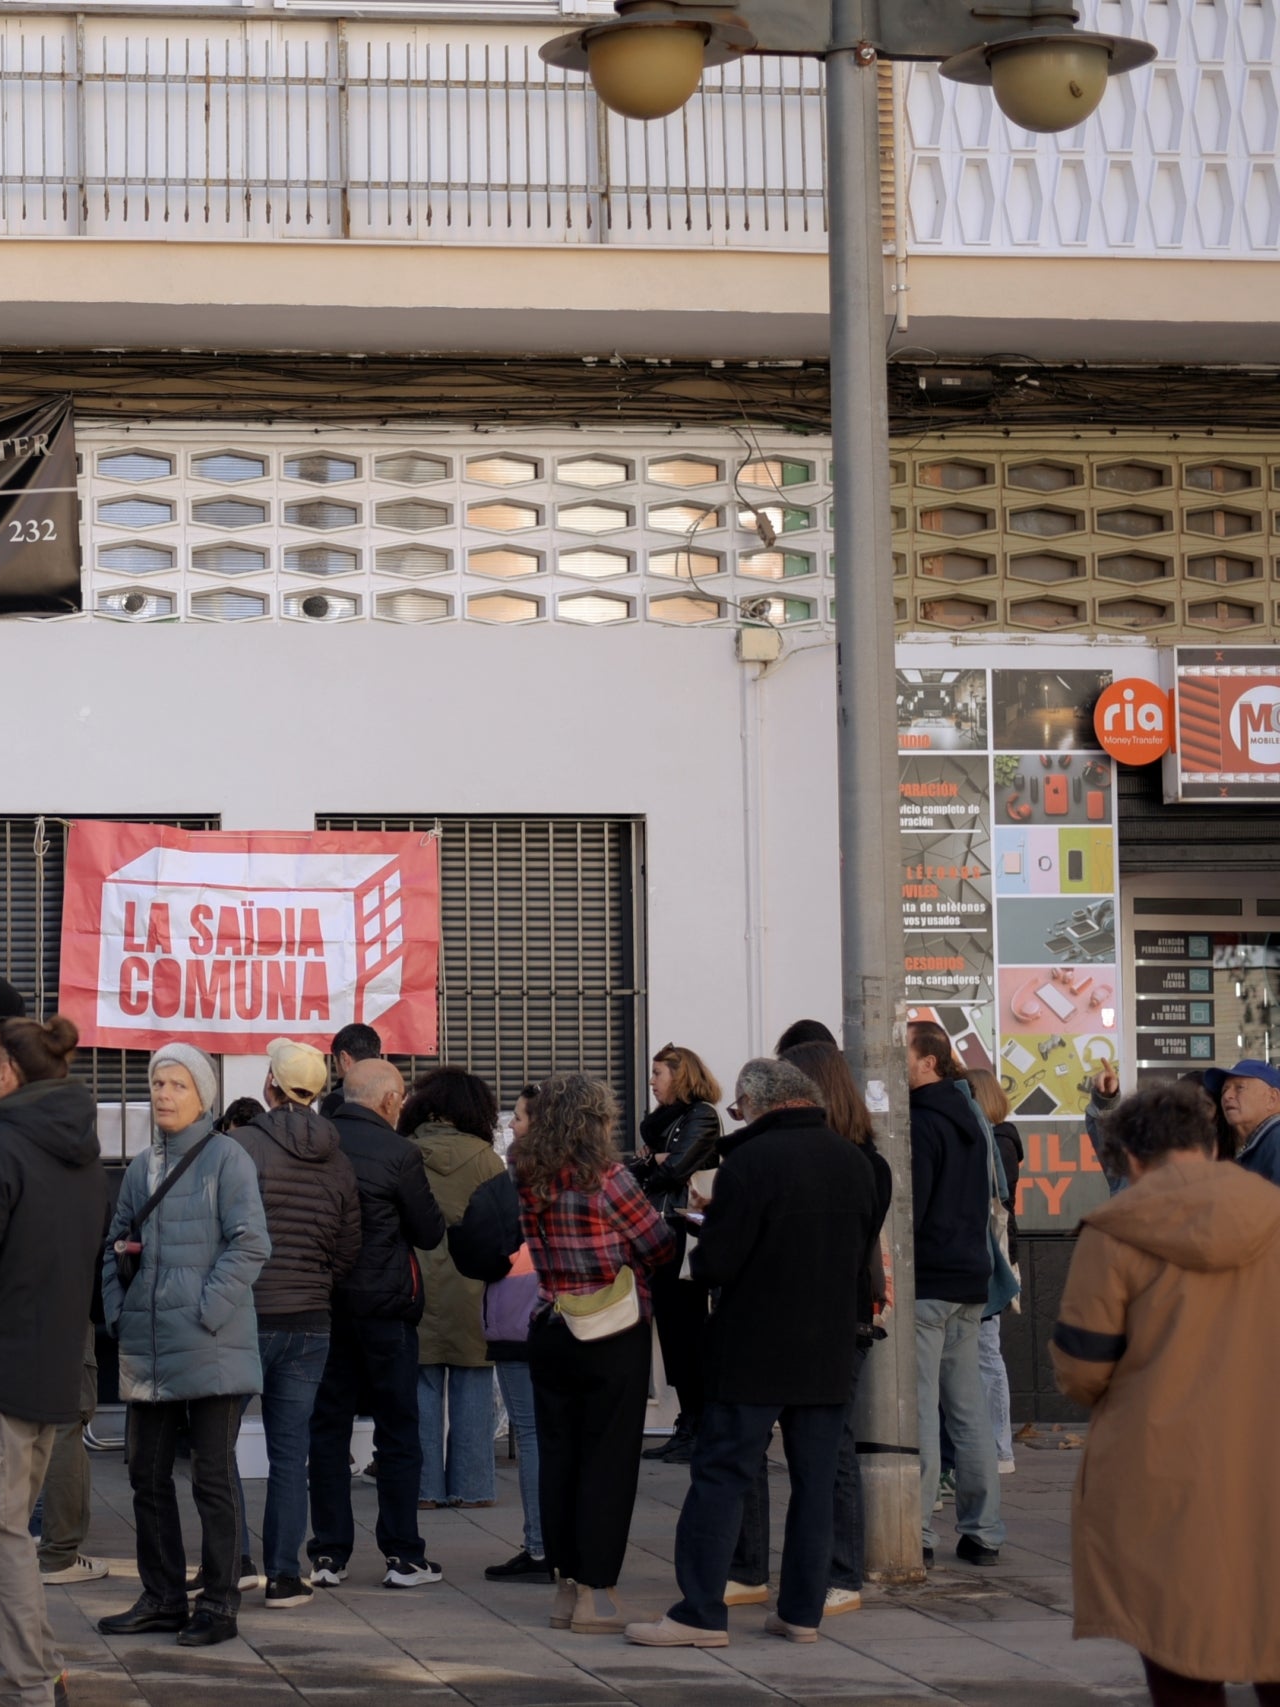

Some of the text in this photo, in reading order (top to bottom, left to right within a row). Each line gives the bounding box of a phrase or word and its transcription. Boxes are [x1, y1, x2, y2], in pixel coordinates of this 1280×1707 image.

[8, 519, 57, 543] 232
[1103, 688, 1164, 731] ria
[1103, 735, 1164, 745] Money Transfer
[923, 804, 965, 815] completo
[968, 804, 979, 814] de
[920, 902, 932, 912] de
[927, 916, 960, 925] usados
[122, 900, 325, 957] LA SAÏDIA
[926, 975, 980, 985] cargadores
[118, 956, 331, 1021] COMUNA
[1171, 1004, 1186, 1012] PACK
[1019, 1133, 1103, 1172] ILE
